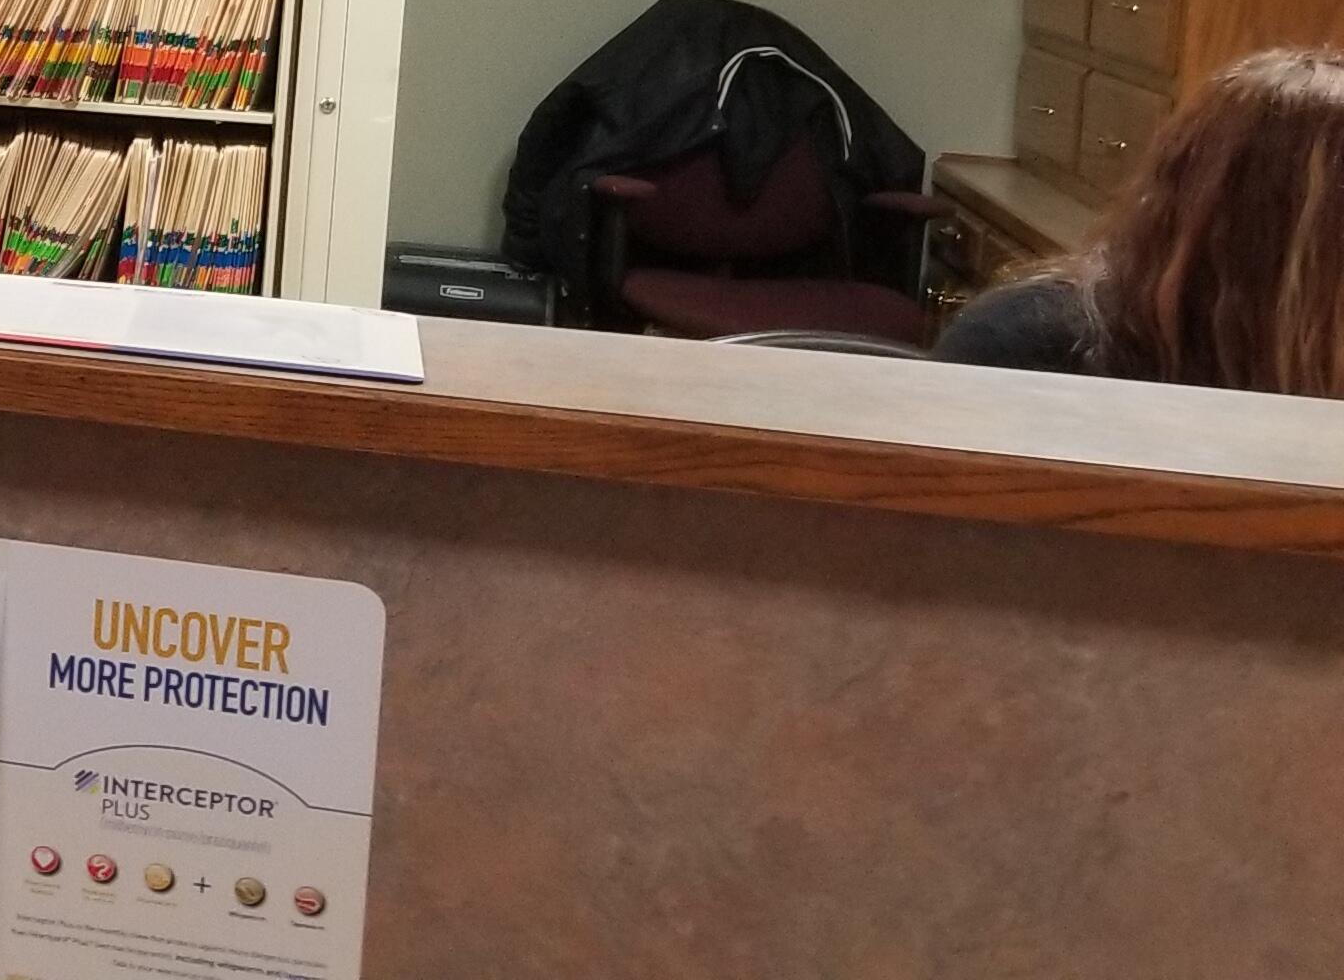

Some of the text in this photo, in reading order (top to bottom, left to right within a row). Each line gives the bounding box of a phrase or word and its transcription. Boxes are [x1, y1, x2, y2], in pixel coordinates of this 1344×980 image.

[92, 598, 292, 675] UNCOVER
[48, 652, 330, 727] MORE PROTECTION
[100, 798, 152, 821] PLUS
[102, 775, 275, 819] INTERCEPTOR
